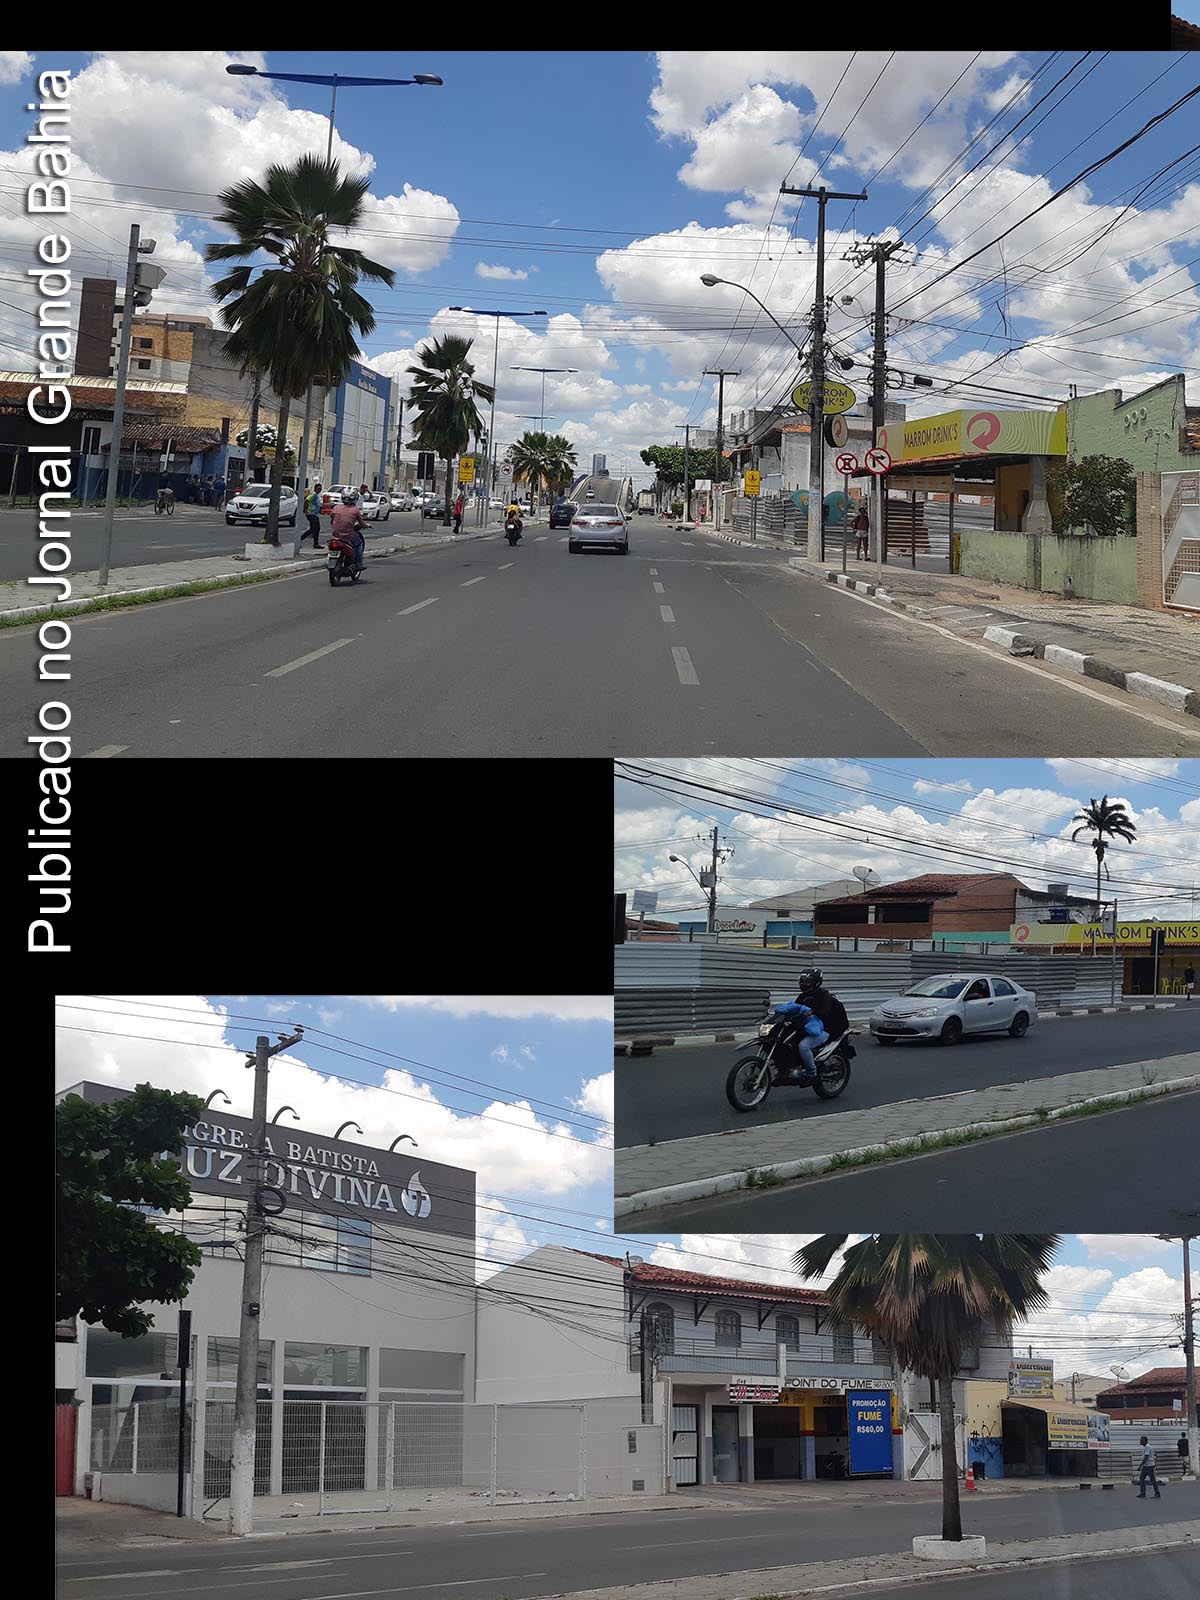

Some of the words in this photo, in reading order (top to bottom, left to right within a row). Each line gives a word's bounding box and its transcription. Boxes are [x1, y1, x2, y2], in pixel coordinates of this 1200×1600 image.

[799, 386, 848, 398] MROM
[904, 428, 932, 449] MARROM
[932, 423, 958, 444] DRINK'S
[1145, 926, 1199, 939] DNK'S
[287, 1141, 381, 1178] BATISTA
[161, 1145, 243, 1185] UZ
[263, 1159, 398, 1214] DIVINA
[785, 1378, 817, 1388] POINT
[821, 1379, 837, 1389] DO
[841, 1380, 873, 1390] FUME
[852, 1398, 887, 1408] PROMOÇÃO
[857, 1408, 883, 1421] FUMÊ
[856, 1425, 885, 1434] R$60,00
